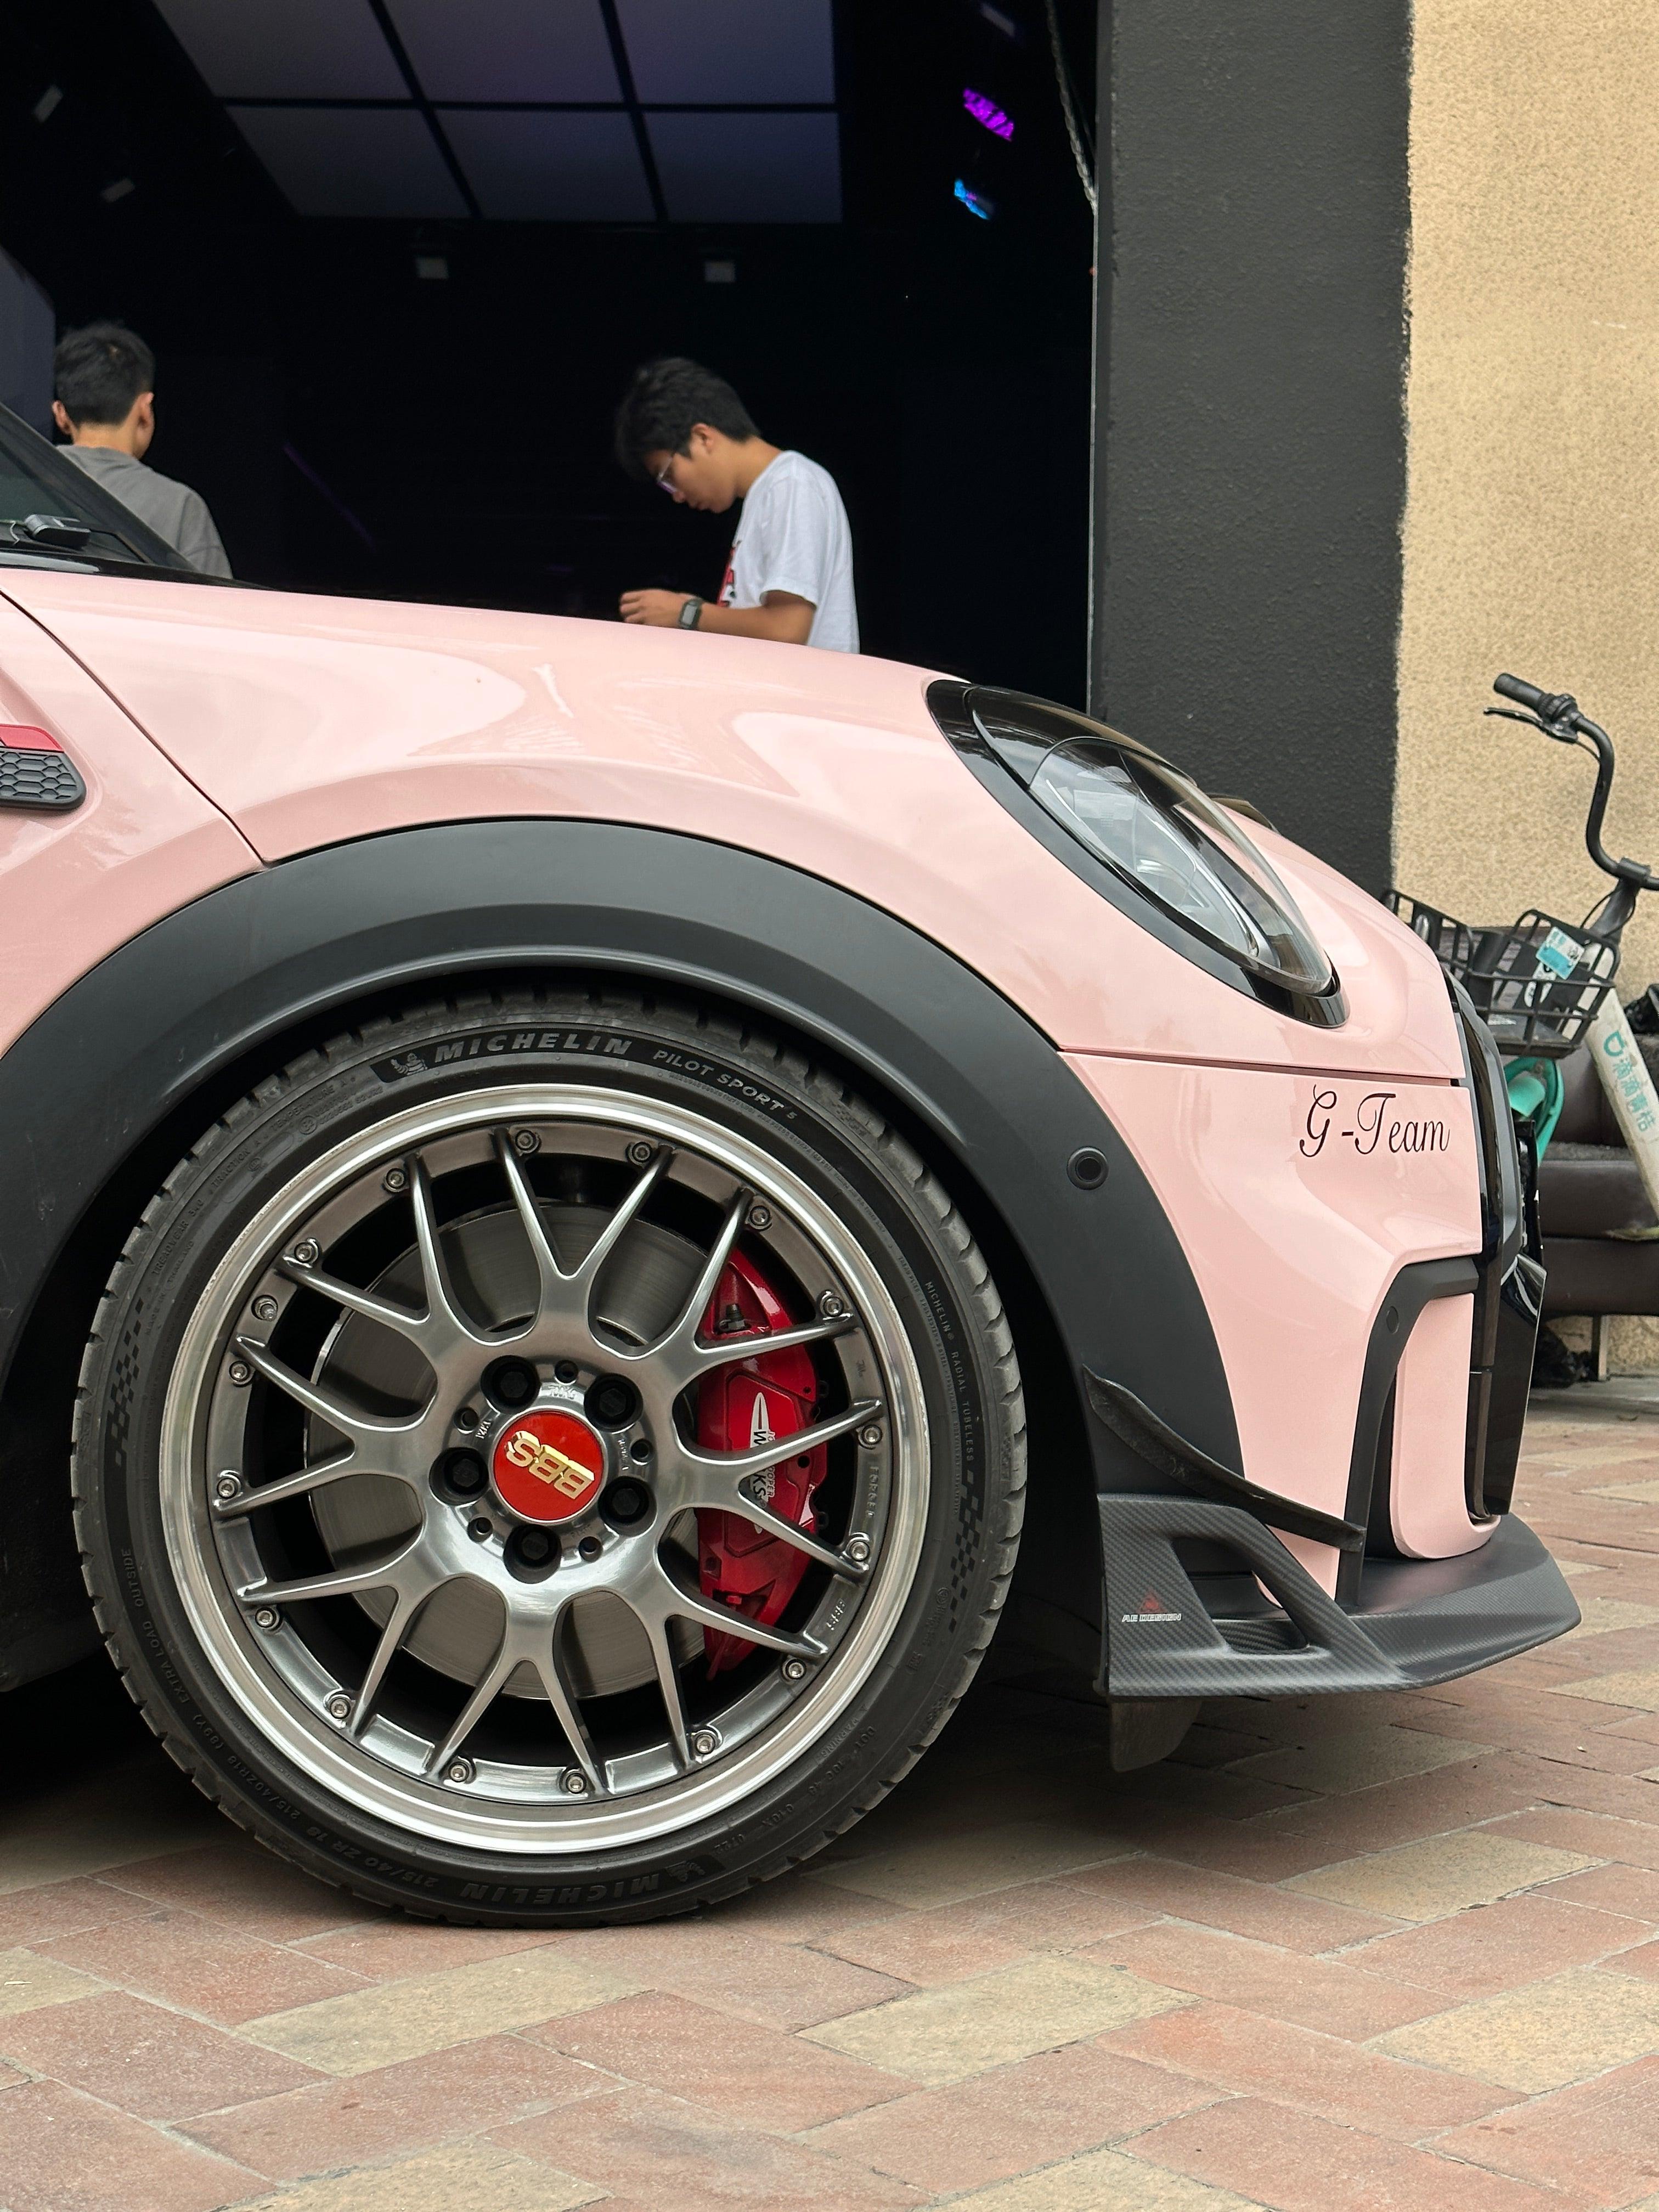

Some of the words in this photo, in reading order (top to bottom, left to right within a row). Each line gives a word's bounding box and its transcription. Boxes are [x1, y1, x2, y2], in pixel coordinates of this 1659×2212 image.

[434, 1031, 632, 1063] MICHELIN
[652, 1049, 715, 1077] PILOT
[716, 1073, 785, 1111] SPORT
[1299, 1084, 1451, 1158] G-Team
[950, 1350, 967, 1392] RADIAL
[961, 1400, 974, 1462] TUBELESS
[503, 1430, 596, 1500] BBS
[753, 1430, 767, 1497] WKS
[120, 1548, 146, 1608] OUTSIDE
[141, 1620, 165, 1657] LOAD
[159, 1659, 191, 1704] EXTRA
[226, 1753, 301, 1820] 215/40ZR18
[330, 1838, 362, 1861] ZR
[363, 1853, 439, 1890] 215/40
[460, 1874, 660, 1904] MICHELIN
